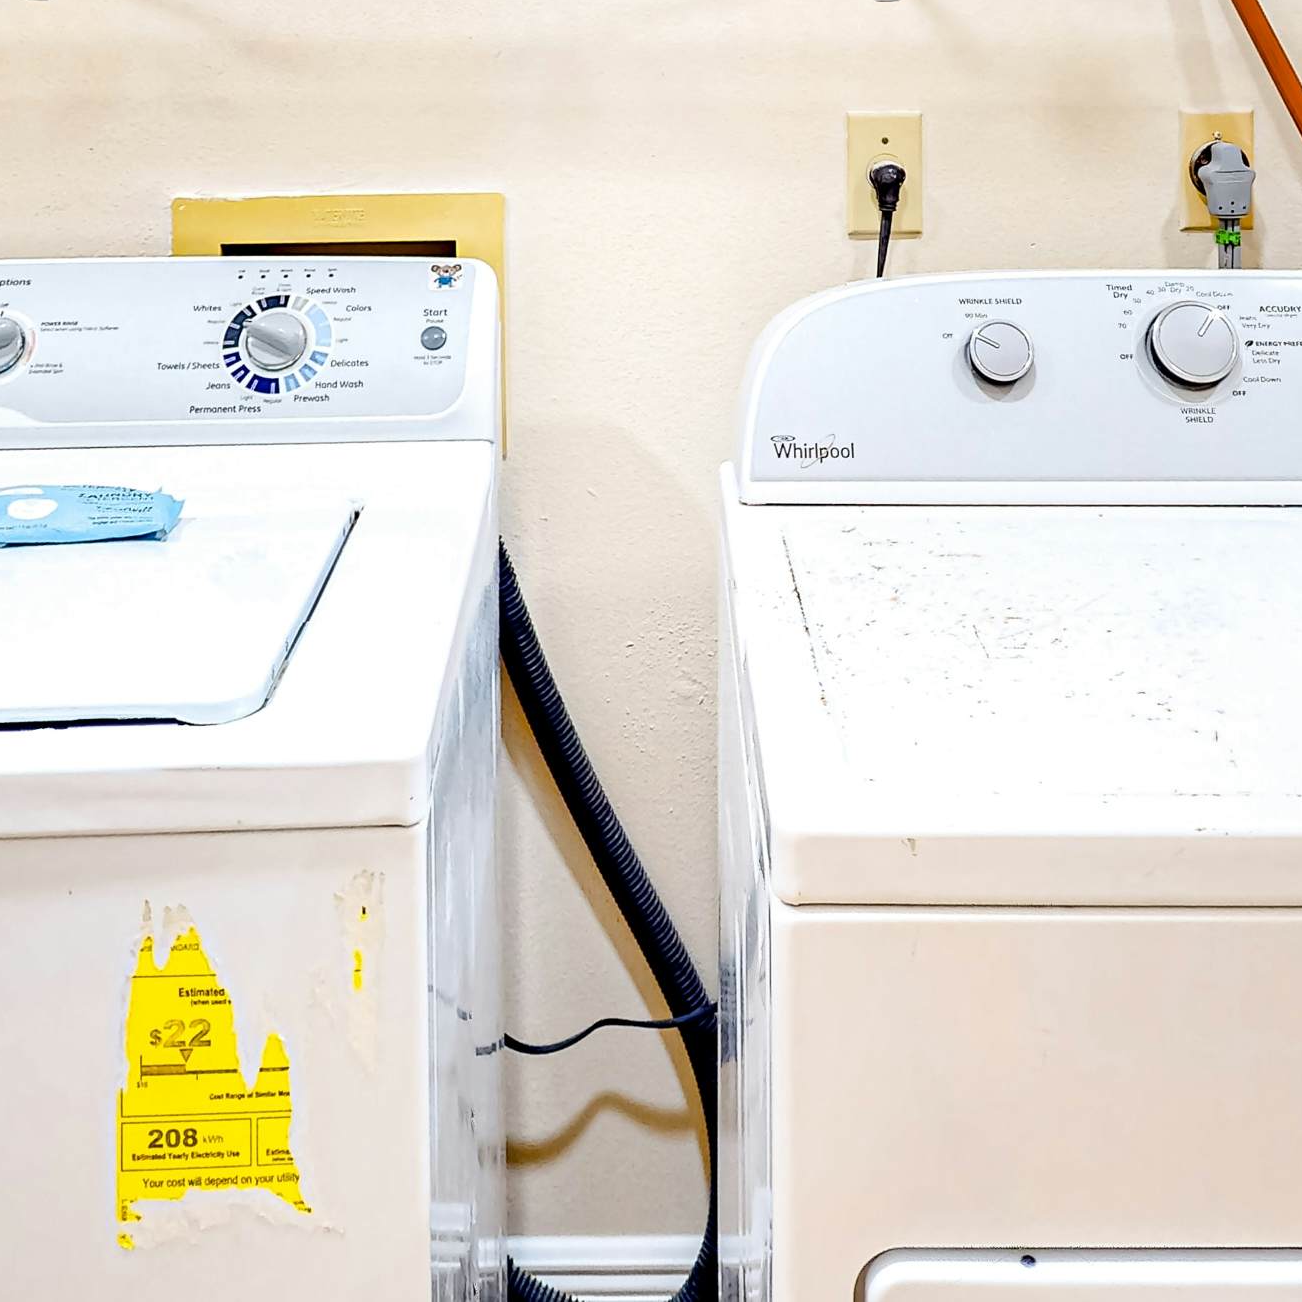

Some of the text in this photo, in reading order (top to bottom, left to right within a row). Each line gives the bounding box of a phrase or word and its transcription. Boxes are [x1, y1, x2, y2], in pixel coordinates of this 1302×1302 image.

[306, 287, 331, 295] Speed
[423, 308, 448, 316] Start
[157, 362, 185, 370] Towels
[206, 381, 231, 390] Jeans
[339, 380, 364, 388] Wash
[293, 394, 330, 402] Prewash
[773, 442, 855, 463] Whirlpool
[179, 988, 225, 997] Estimated
[149, 1018, 212, 1048] $22
[147, 1128, 224, 1149] 208 kWh
[132, 1153, 166, 1161] Estimated
[168, 1153, 190, 1161] Yearly
[191, 1151, 226, 1160] Electricity
[143, 1173, 300, 1189] Your cost will depend on your utility
